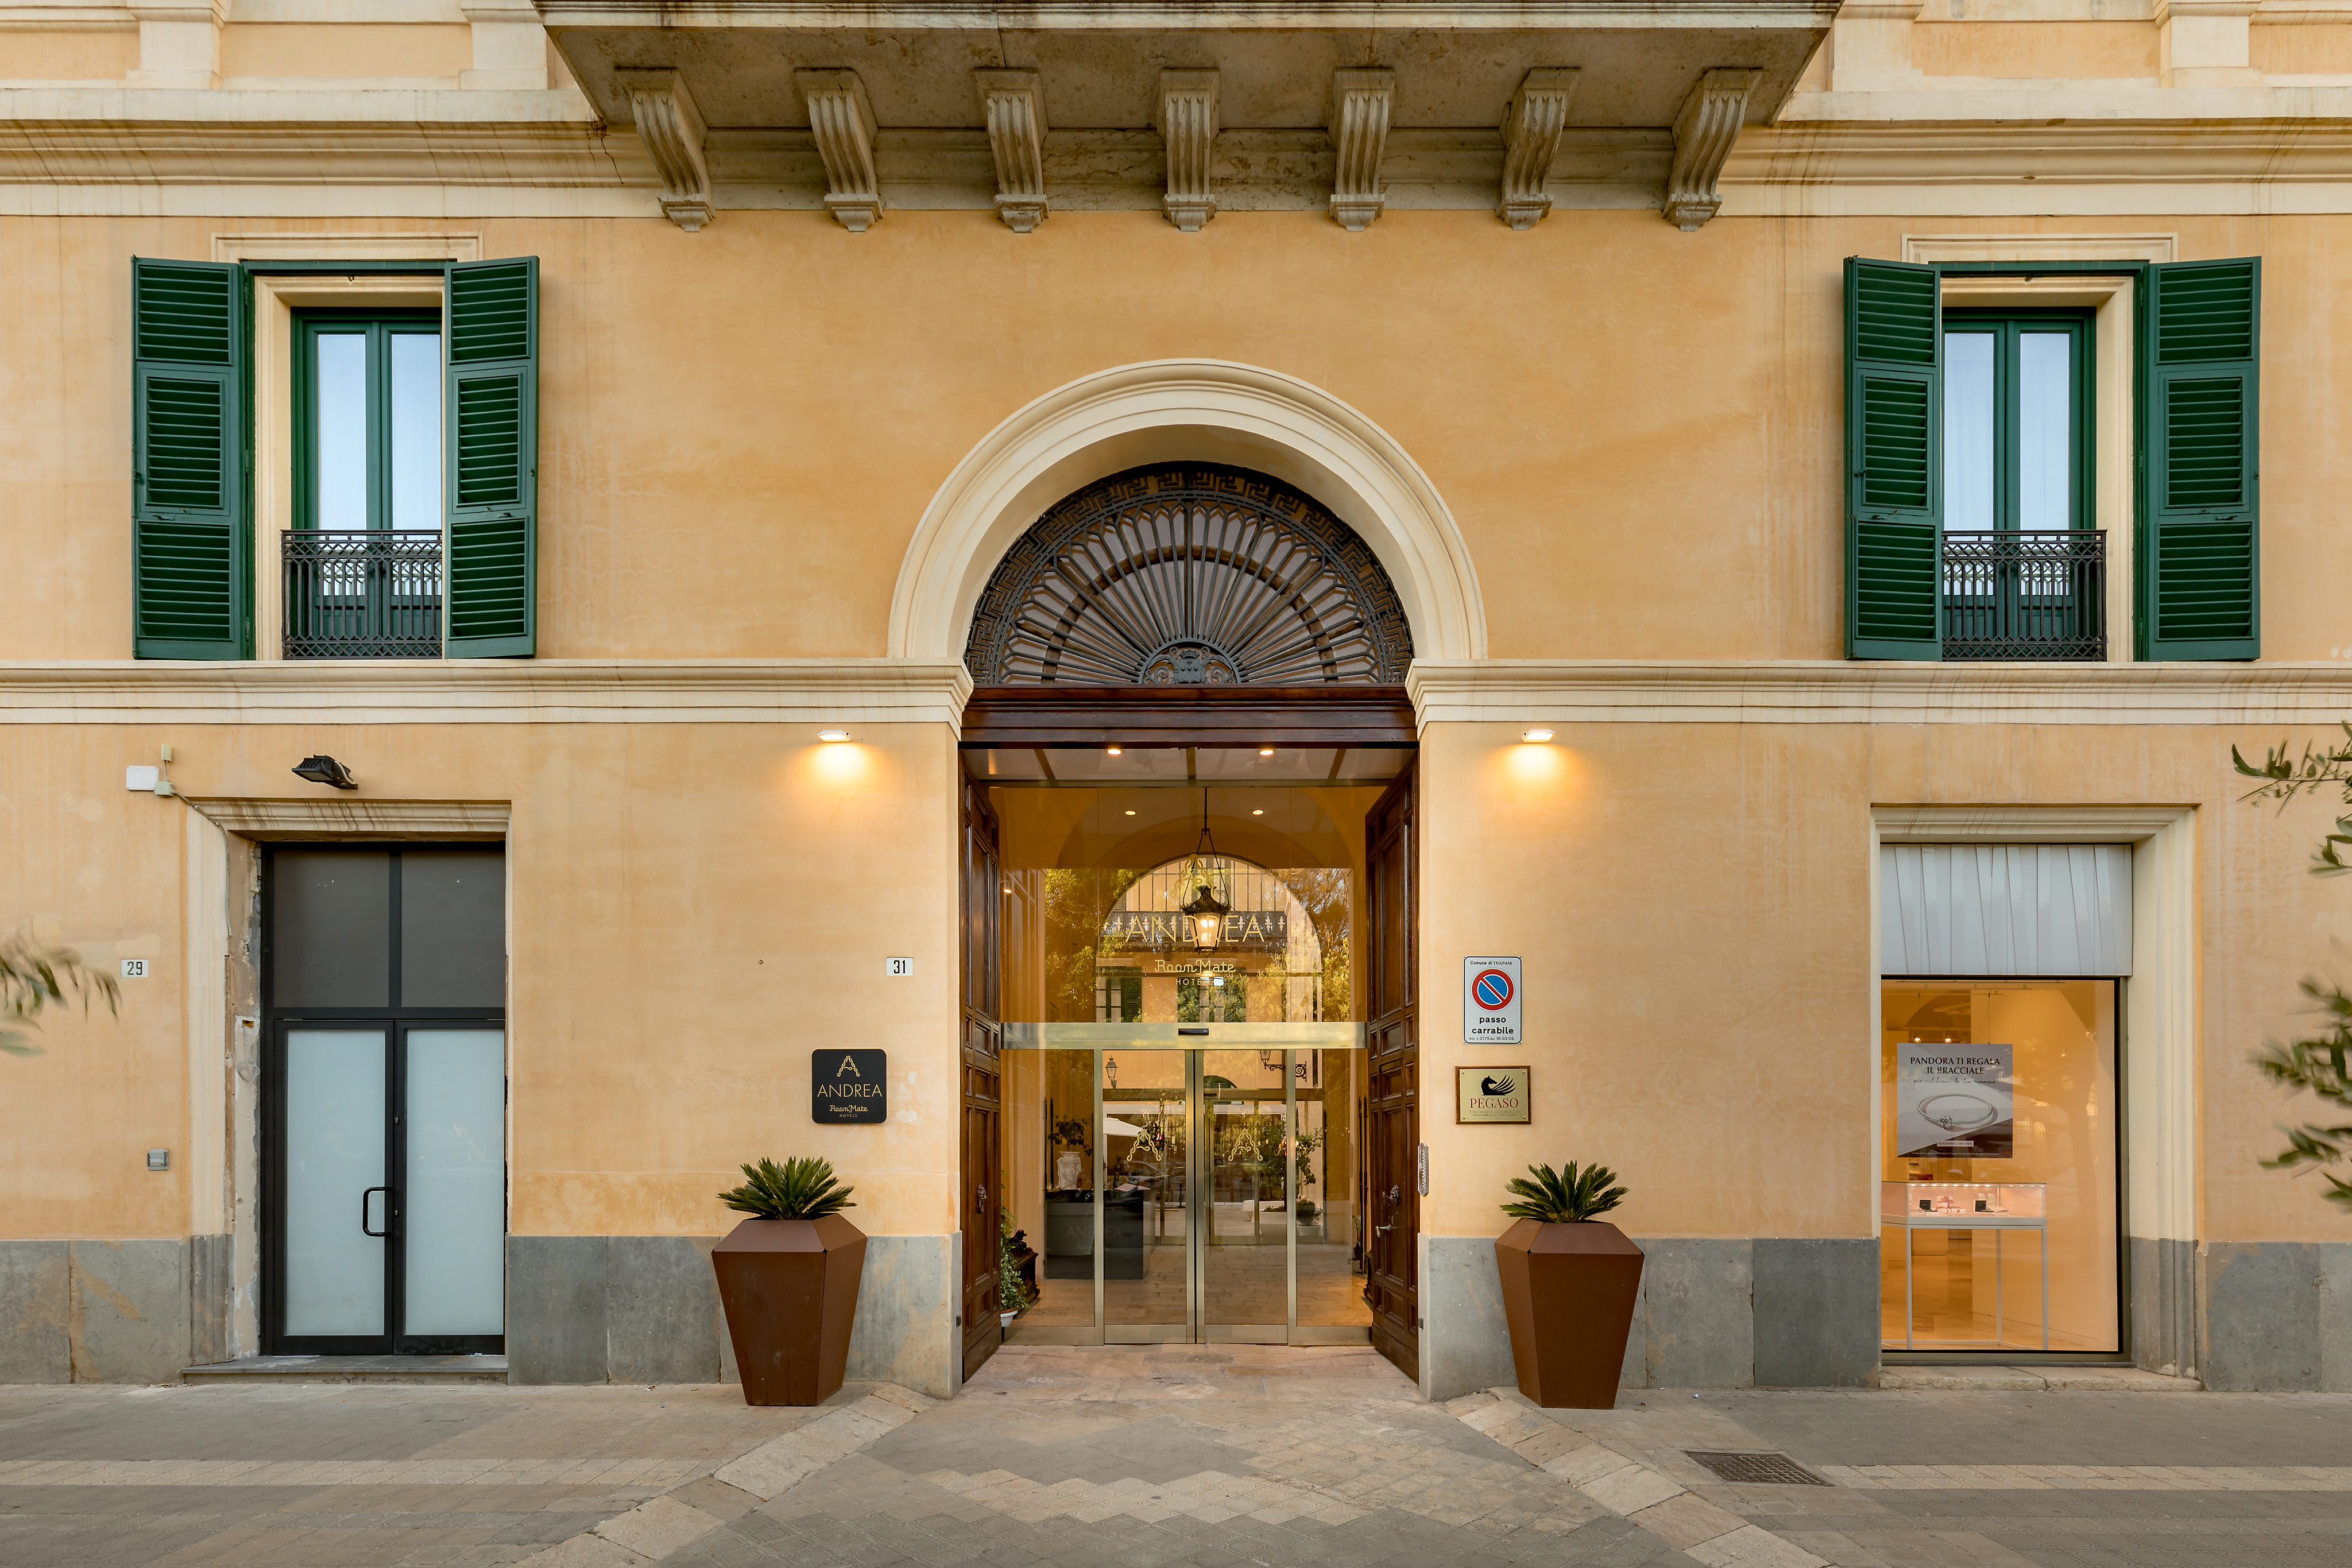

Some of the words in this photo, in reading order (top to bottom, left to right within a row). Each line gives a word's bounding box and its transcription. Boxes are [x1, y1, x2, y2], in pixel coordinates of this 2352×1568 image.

[1125, 915, 1265, 943] ANDREA
[127, 961, 142, 975] 29
[893, 960, 906, 974] 31
[817, 1084, 883, 1097] ANDREA
[1470, 1098, 1519, 1108] PEGASO
[1066, 1226, 1122, 1238] ANDEA
